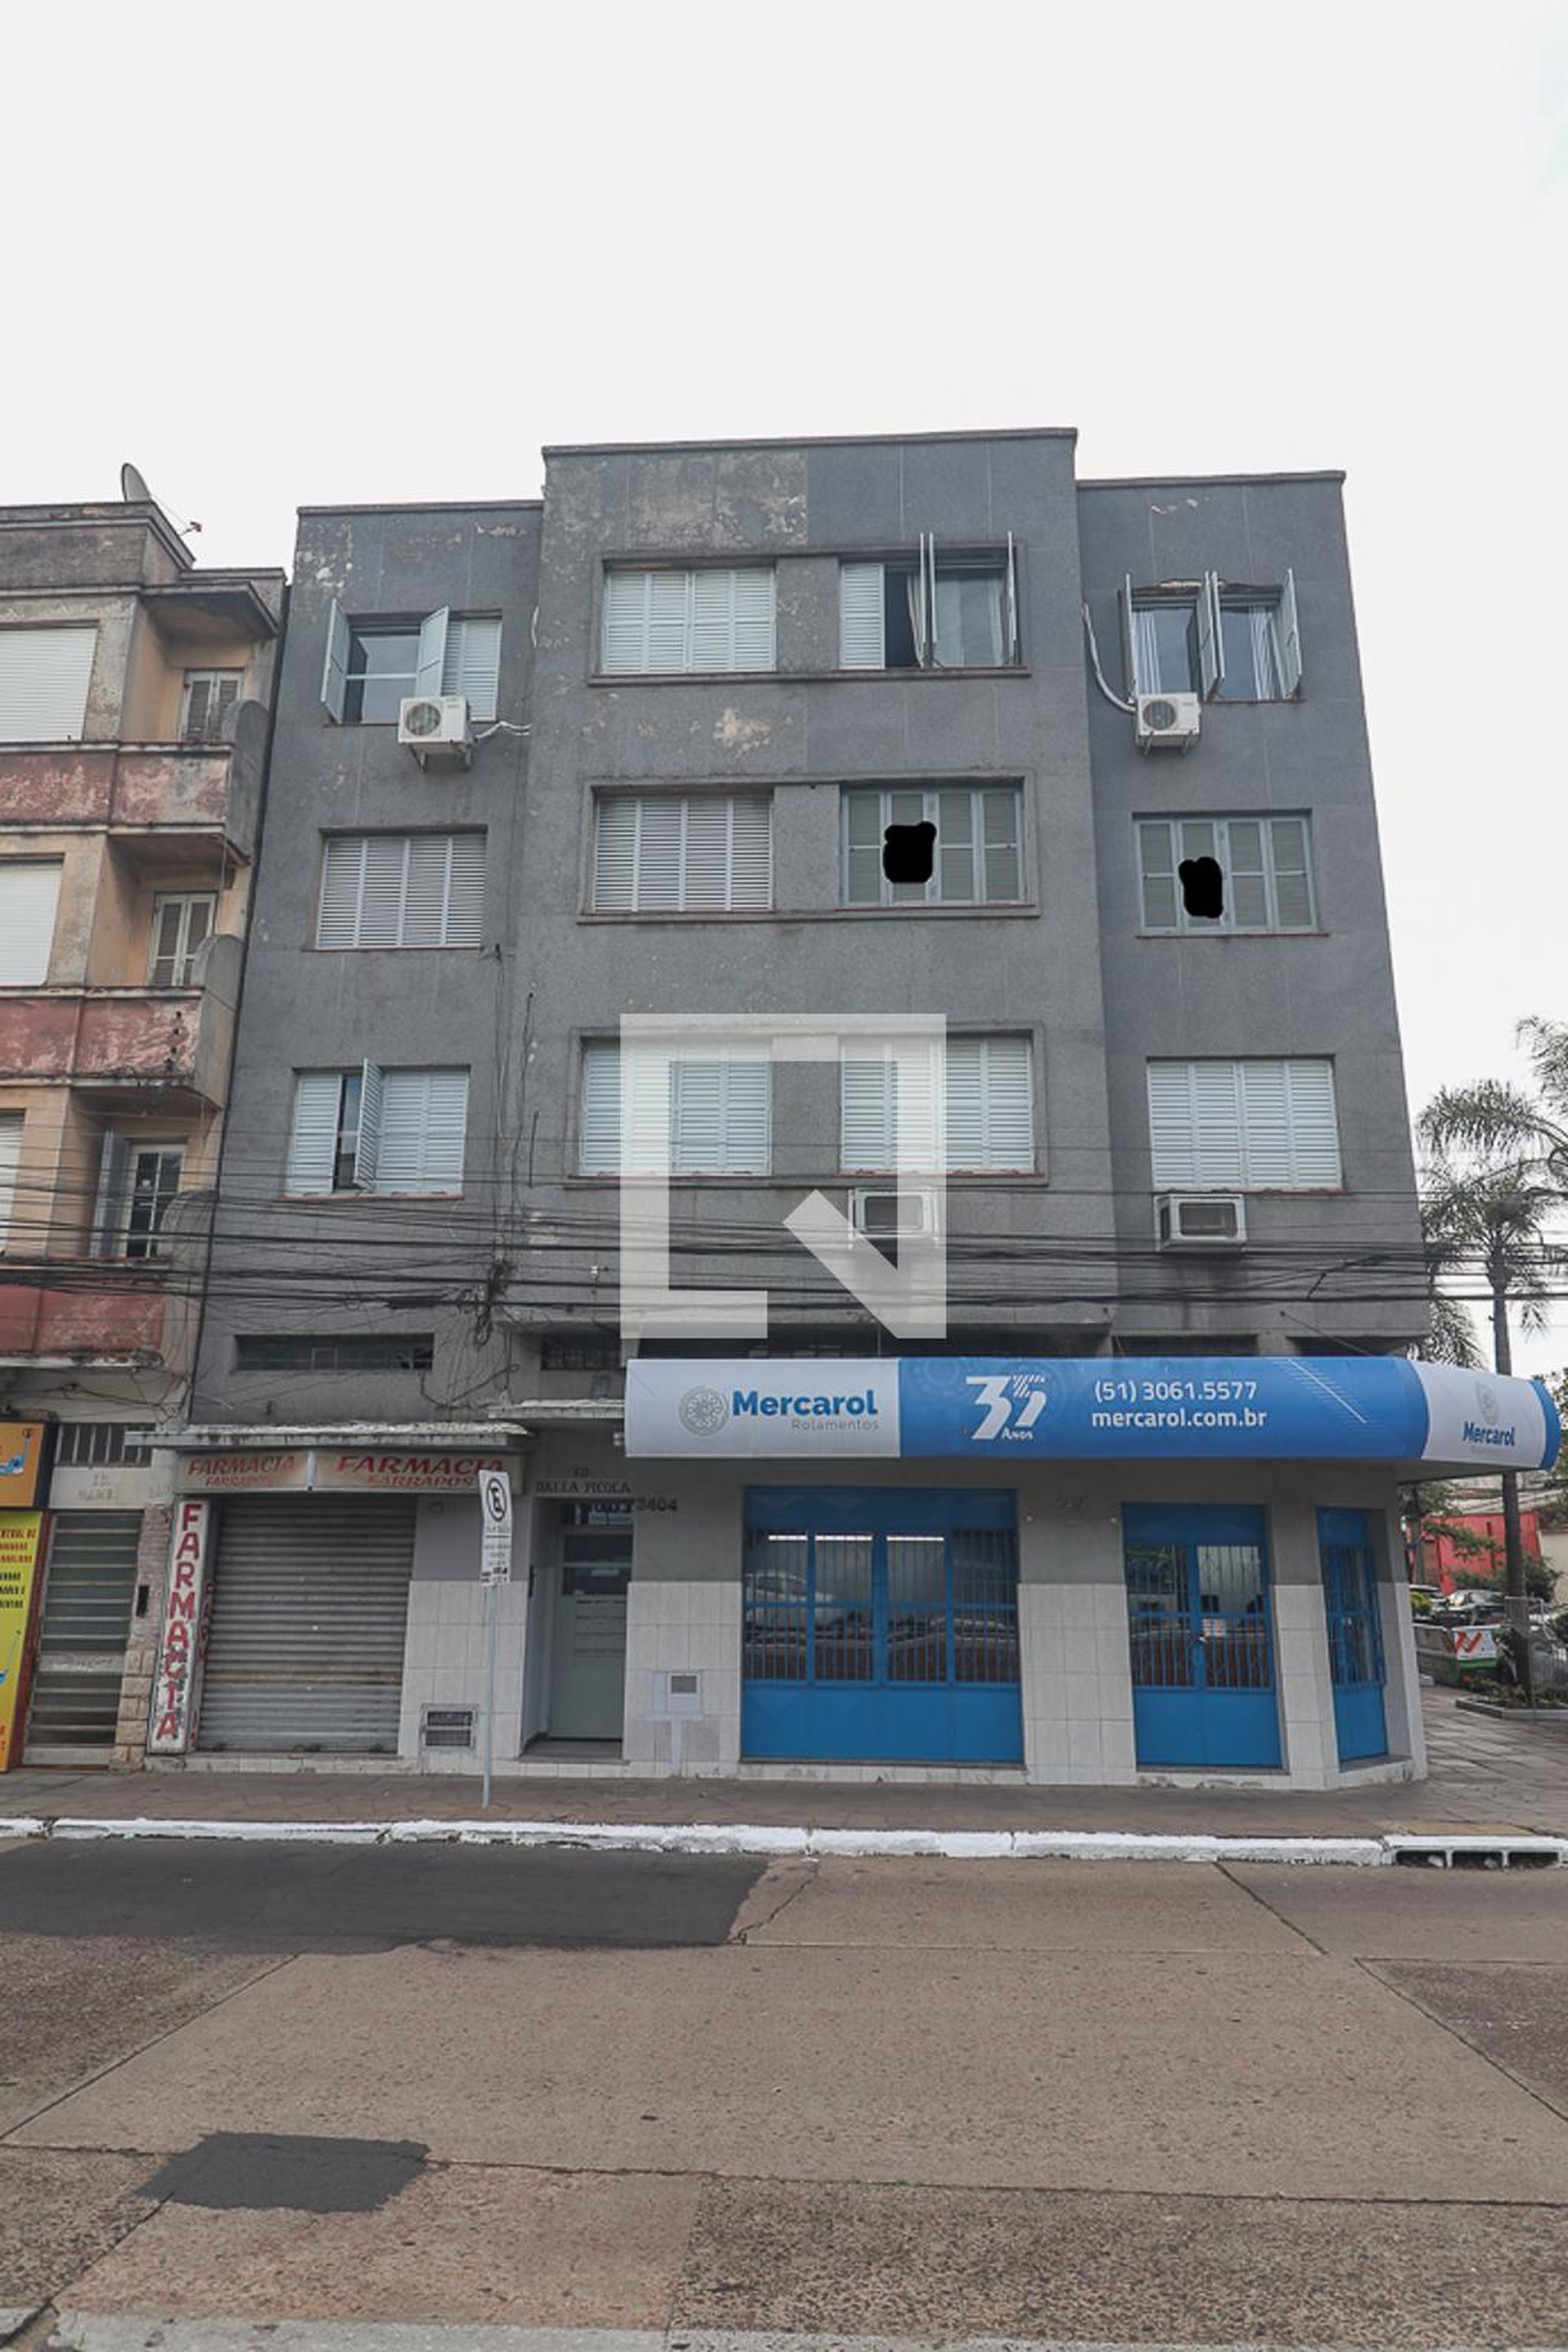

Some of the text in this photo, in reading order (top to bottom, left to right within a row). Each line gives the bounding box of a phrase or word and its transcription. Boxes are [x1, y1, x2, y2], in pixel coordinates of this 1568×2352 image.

[1095, 1381, 1257, 1403] (51) 3061.5577
[733, 1390, 878, 1416] Mercarol
[792, 1420, 880, 1430] Rolamentos
[1091, 1407, 1267, 1427] mercarol.com.br
[1463, 1421, 1515, 1446] Mercarol
[188, 1455, 294, 1475] FARMACIA
[336, 1455, 503, 1475] FARMACIA
[368, 1474, 476, 1487] FARRAPOS
[156, 1504, 202, 1741] FARMACIA
